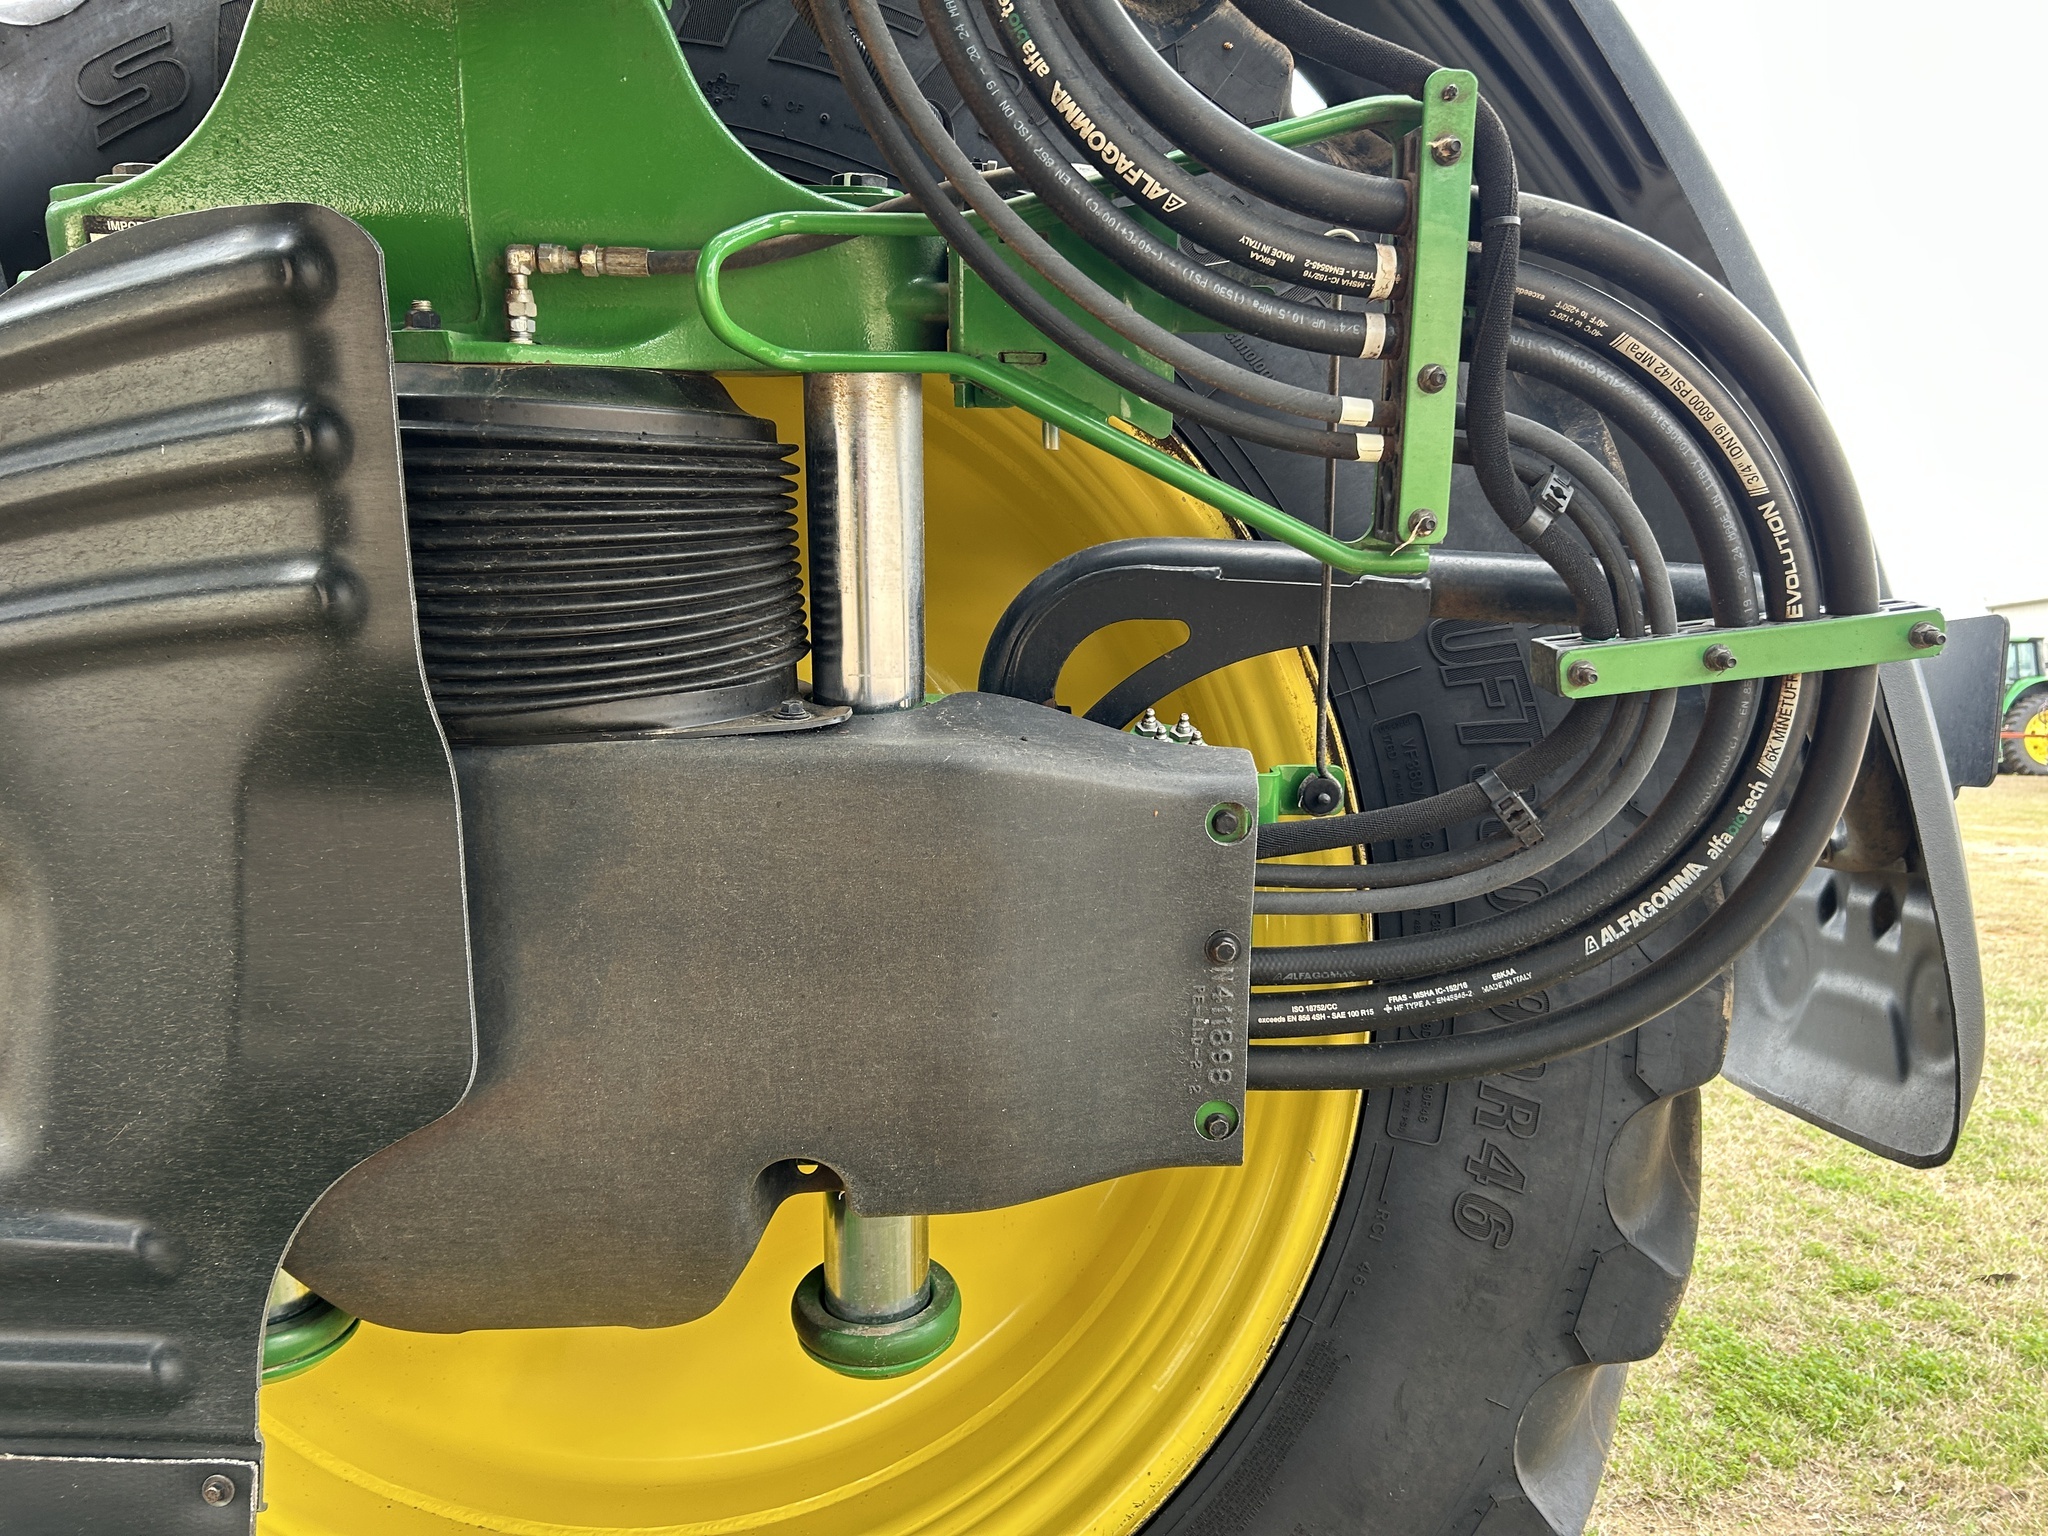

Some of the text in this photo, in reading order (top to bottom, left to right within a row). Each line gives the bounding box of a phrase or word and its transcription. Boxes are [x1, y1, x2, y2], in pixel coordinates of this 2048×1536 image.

[944, 0, 960, 17] MA
[954, 23, 970, 40] 24
[986, 80, 1000, 97] 19
[999, 100, 1015, 118] DN
[1050, 79, 1170, 200] ALFAGOMMA
[1033, 147, 1055, 169] 857
[1055, 168, 1072, 187] EN
[107, 220, 144, 232] IMPO
[1238, 235, 1263, 250] ITALY
[1270, 249, 1296, 263] MADE
[1303, 258, 1345, 276] EN45545-2
[1182, 266, 1208, 289] PSI)
[1341, 278, 1365, 288] MSHA
[1211, 283, 1245, 306] (1530
[1515, 286, 1546, 301] exceeds
[1252, 298, 1273, 316] MPa
[1278, 309, 1304, 325] 10.5
[1311, 318, 1326, 330] WP
[1333, 321, 1361, 335] 3/4"
[1626, 341, 1803, 619] EVOLUTION 3/4" (DN19) 6000 PSI (42 MPa)
[1710, 495, 1726, 509] IN
[1731, 546, 1746, 561] 24
[1739, 701, 1750, 716] EN
[1599, 862, 1708, 948] ALFAGOMMA
[1706, 780, 1768, 860] alfabiotech
[1765, 746, 1781, 762] 6K
[1481, 971, 1533, 993] MADE IN ITALY
[1388, 993, 1408, 1004] FRAS
[1412, 989, 1435, 1000] MSHA
[1291, 1003, 1338, 1013] ISO 18752/CC
[1393, 1003, 1405, 1012] HF
[1404, 1001, 1425, 1011] TYPE
[1258, 1015, 1286, 1024] exceeds
[1311, 1013, 1326, 1021] 4SH
[1331, 1012, 1346, 1020] SAE
[1347, 1010, 1359, 1018] 100
[1360, 1008, 1375, 1016] R15
